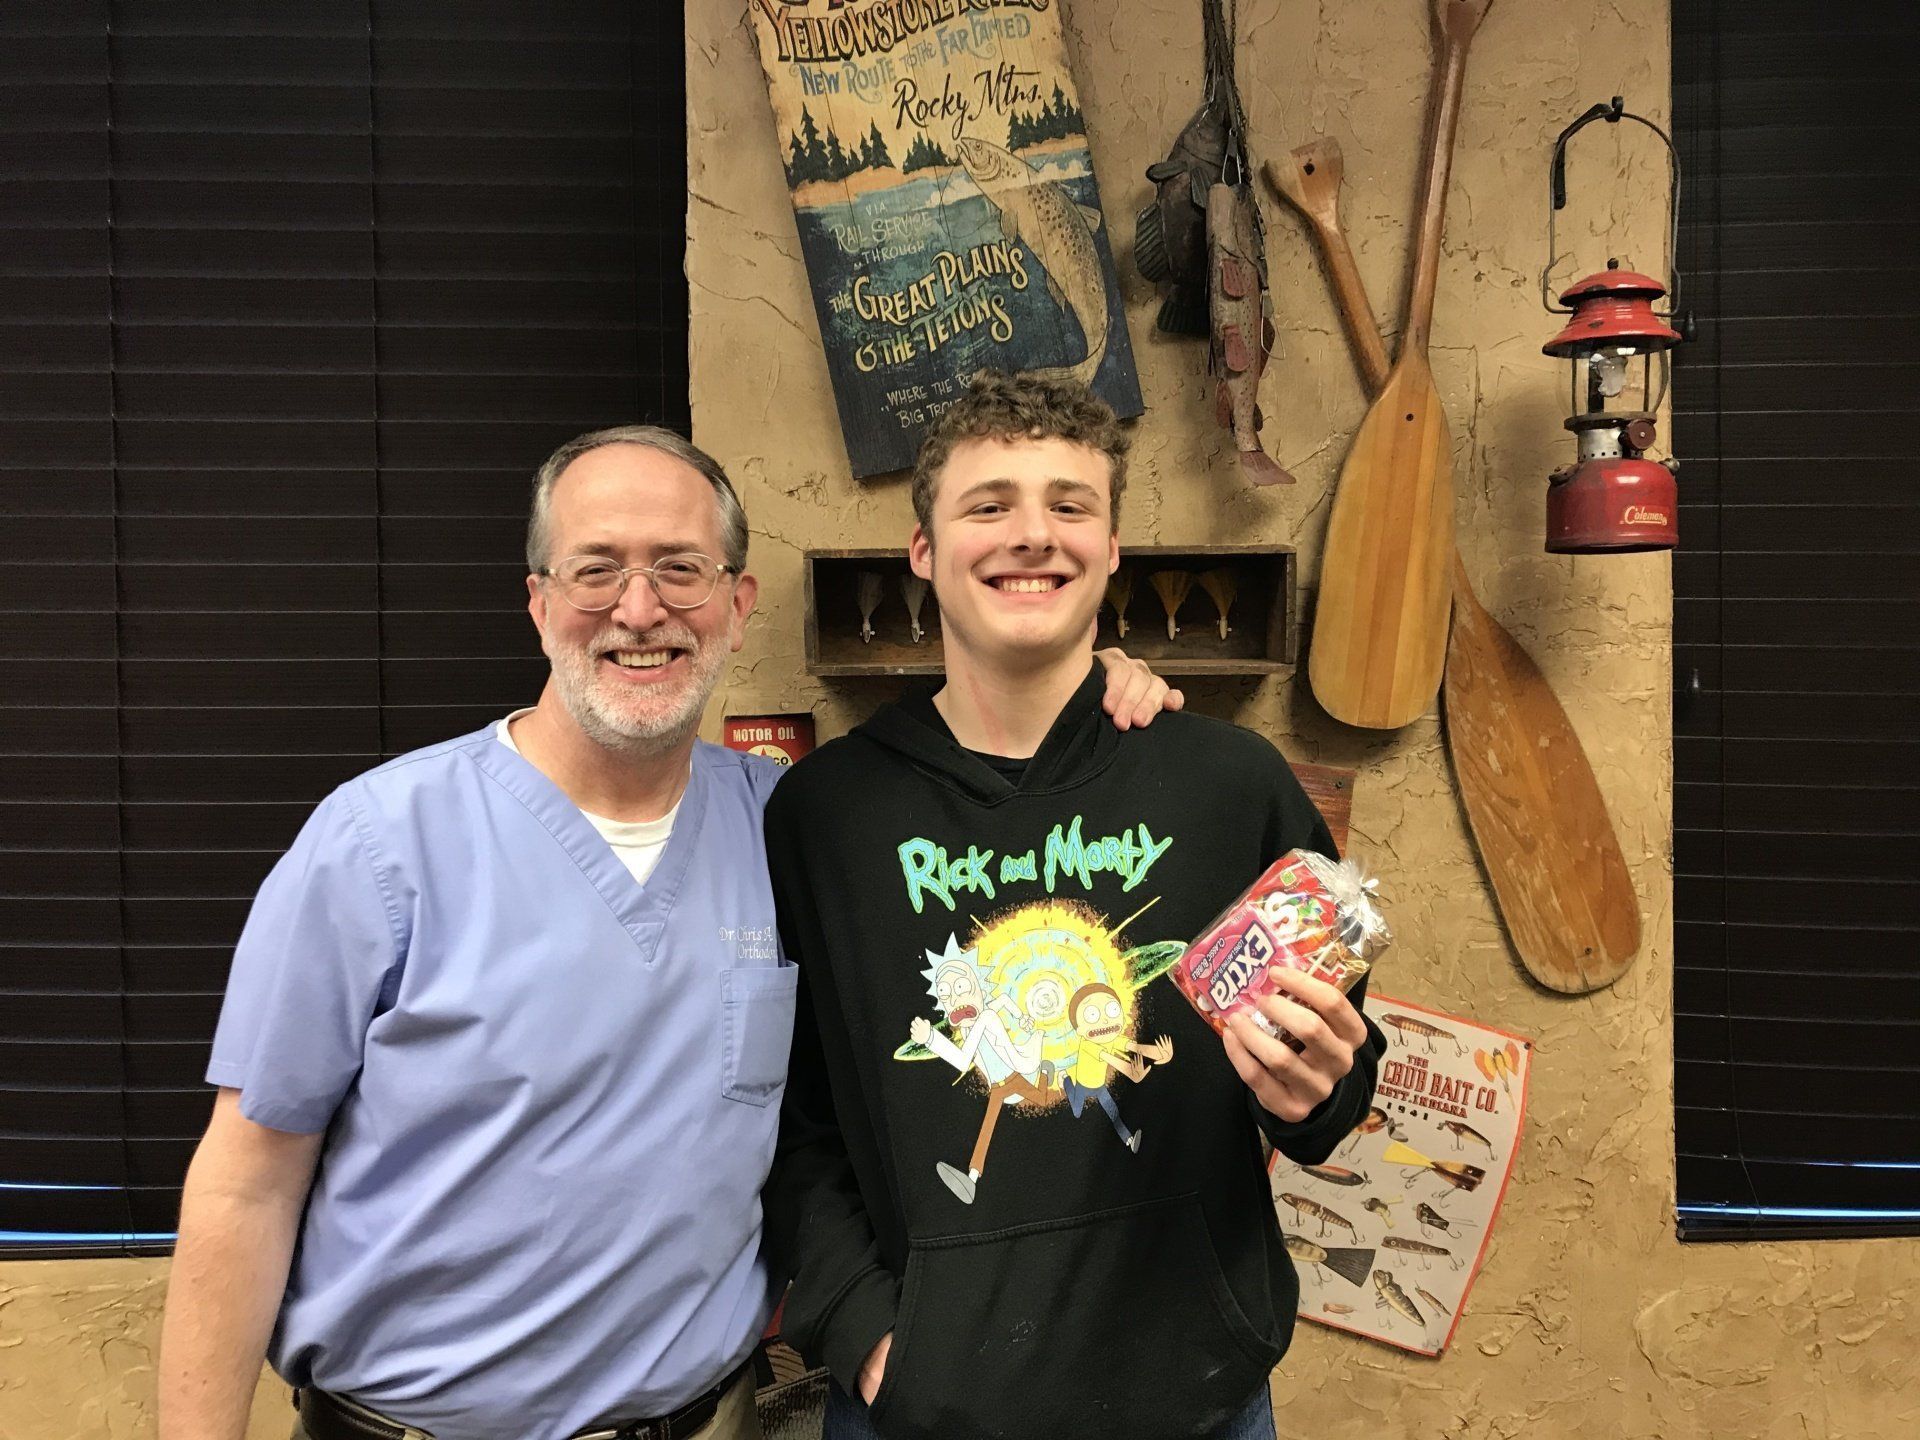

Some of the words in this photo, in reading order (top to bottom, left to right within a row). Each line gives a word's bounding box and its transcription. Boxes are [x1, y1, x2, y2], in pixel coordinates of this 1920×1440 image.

[758, 0, 954, 62] YELLOWSTONE
[796, 63, 840, 97] NEW
[842, 55, 898, 101] ROUTE
[936, 25, 973, 67] FAR
[965, 8, 1031, 49] FAMED
[892, 73, 970, 141] Rocky
[968, 61, 1042, 121] Mtns.
[865, 201, 888, 217] VIA
[829, 223, 868, 254] RAIL
[829, 290, 853, 314] THE
[853, 272, 938, 326] GREAT
[931, 241, 1030, 290] PLAINS
[855, 330, 879, 373] &
[878, 330, 916, 365] THE
[909, 286, 1013, 353] TETONS
[931, 378, 953, 396] THE
[896, 408, 925, 429] BIG
[1625, 505, 1667, 526] Coleman
[733, 727, 773, 742] MOTOR
[778, 726, 796, 741] OIL
[1206, 937, 1227, 962] CLASSIC
[1191, 958, 1210, 981] BUBBLE
[1209, 921, 1276, 1011] Extra
[1407, 1054, 1429, 1069] THE
[1383, 1060, 1428, 1093] CHUB
[1429, 1073, 1474, 1106] BAIT
[1476, 1086, 1499, 1115] CO.
[1386, 1102, 1429, 1121] 1941
[1411, 1094, 1468, 1119] INDIANA
